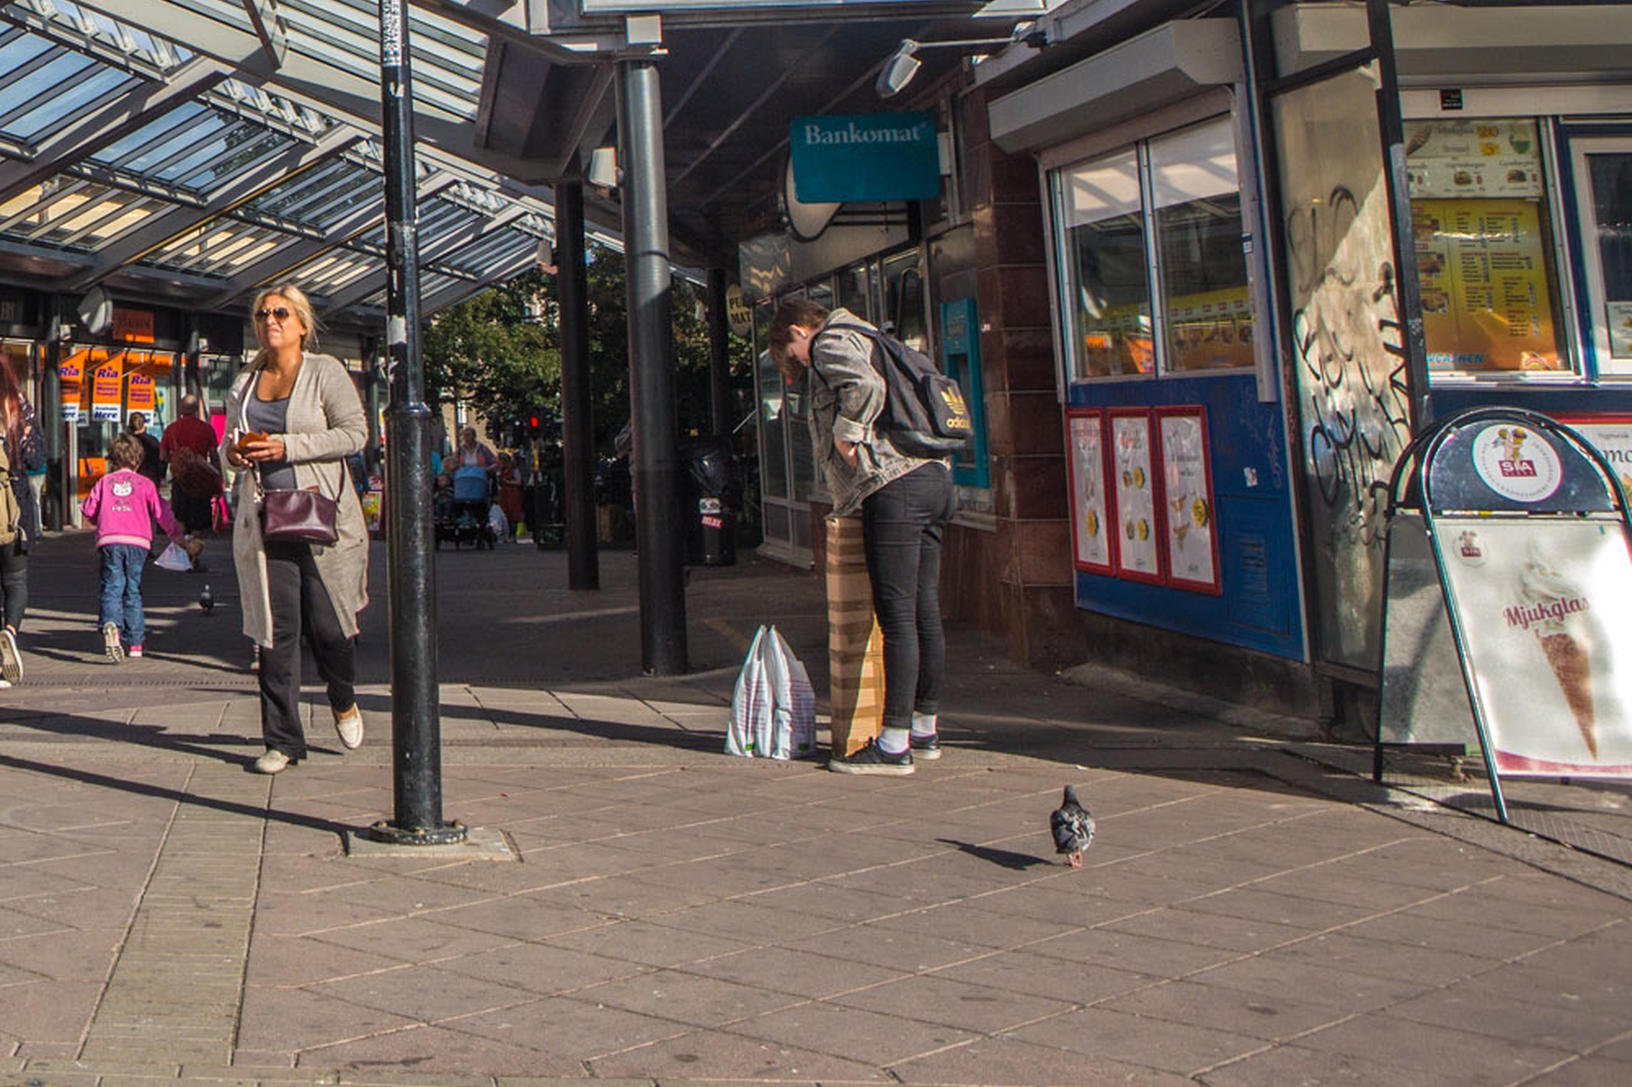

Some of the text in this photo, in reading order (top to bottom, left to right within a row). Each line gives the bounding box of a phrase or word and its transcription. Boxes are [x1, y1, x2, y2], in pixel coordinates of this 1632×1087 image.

[805, 122, 921, 145] Bankomat
[58, 364, 80, 377] Ria
[97, 366, 118, 379] Ria
[131, 373, 151, 385] Ria
[1501, 459, 1534, 474] SIA
